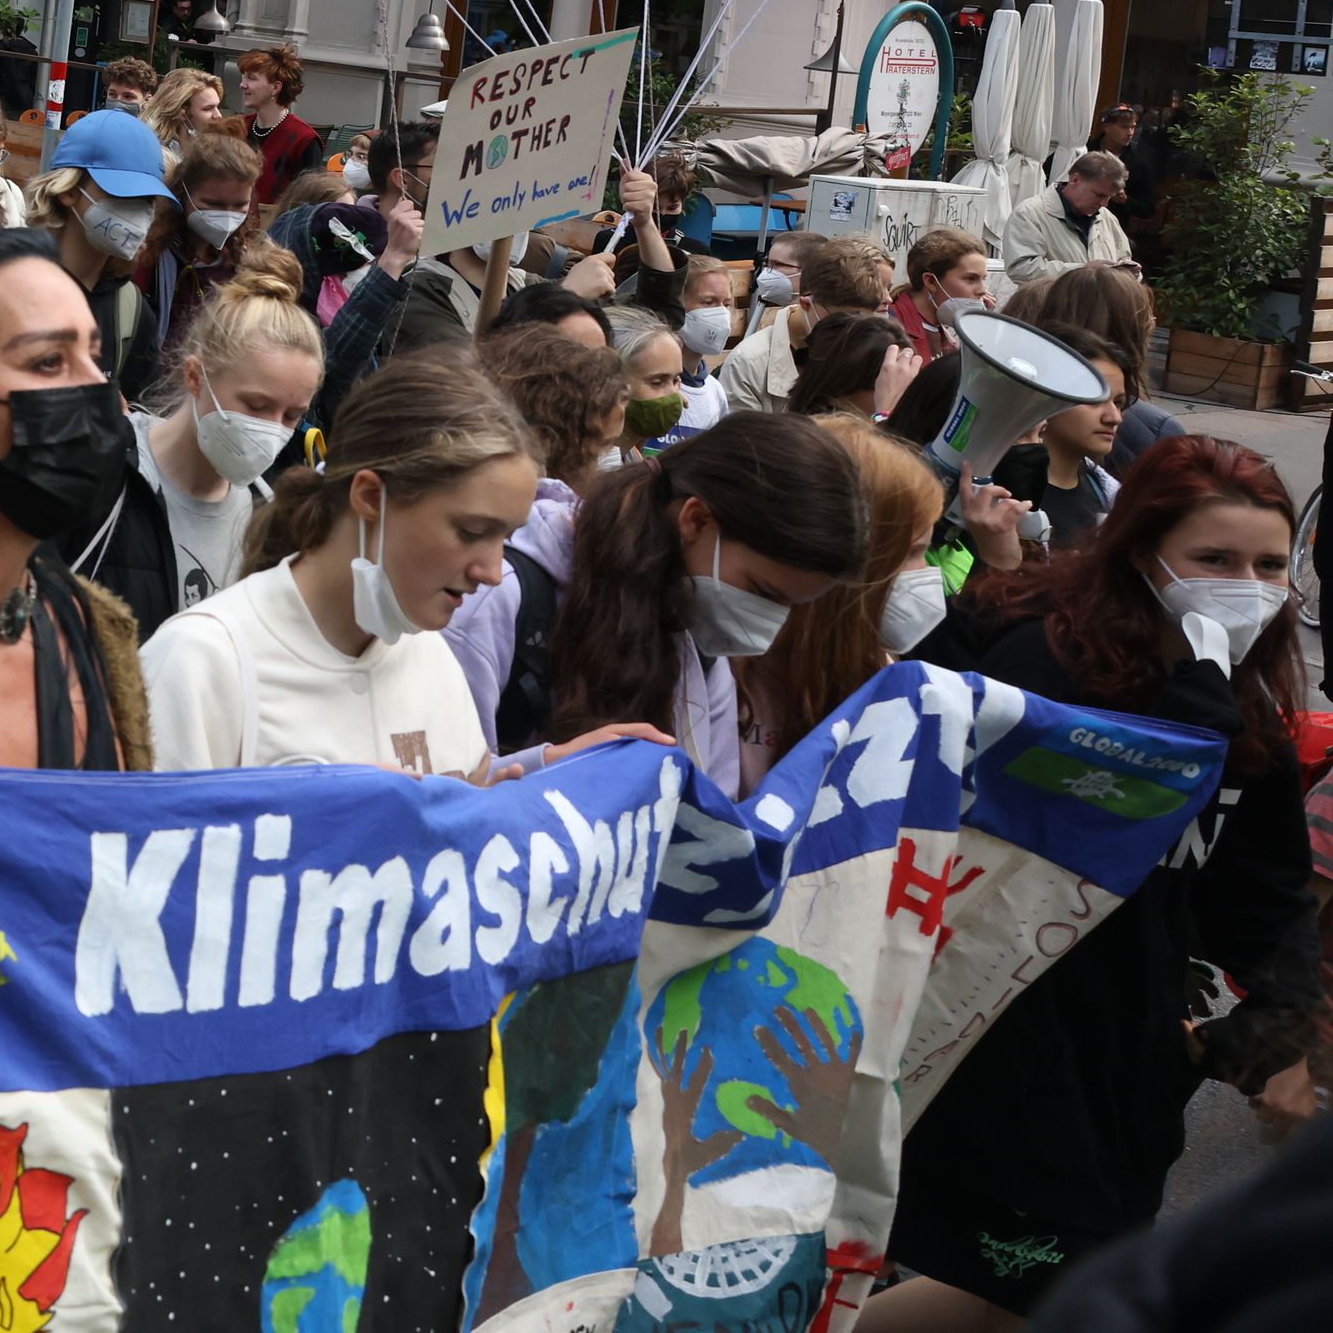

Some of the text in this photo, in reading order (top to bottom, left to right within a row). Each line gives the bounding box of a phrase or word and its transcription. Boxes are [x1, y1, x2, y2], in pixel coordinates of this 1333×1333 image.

[881, 46, 937, 60] HOTEL
[470, 48, 596, 110] RESPECT
[489, 96, 536, 131] OUR
[441, 164, 597, 228] We only have one!
[94, 217, 140, 248] ACT
